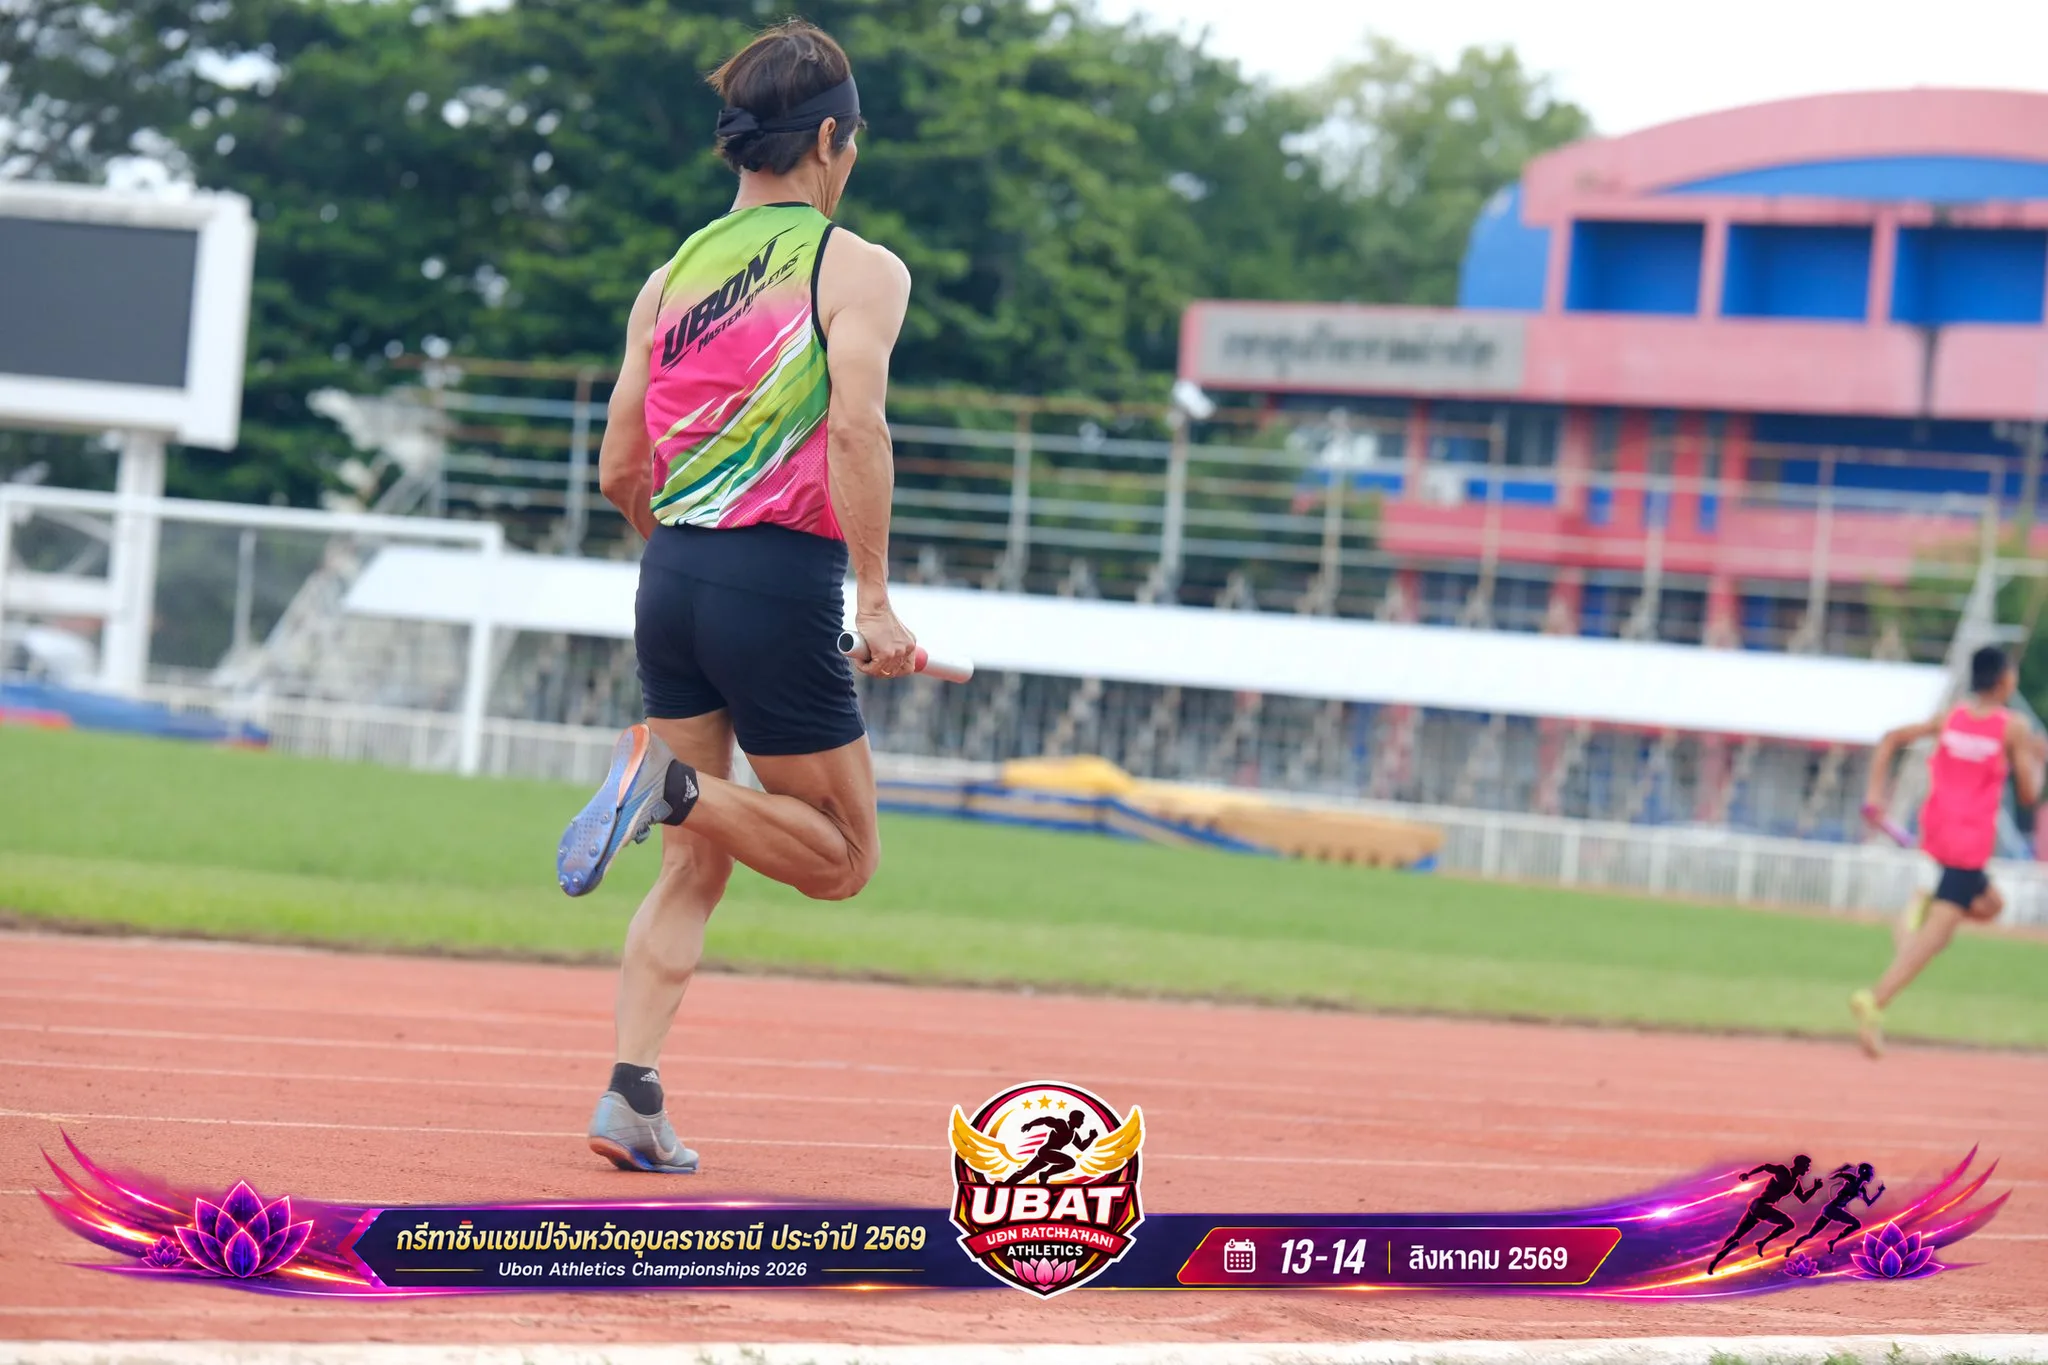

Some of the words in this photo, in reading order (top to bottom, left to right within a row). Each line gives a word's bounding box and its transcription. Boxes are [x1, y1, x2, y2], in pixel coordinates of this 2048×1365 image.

[660, 238, 778, 368] UBON
[697, 308, 742, 354] MASTER
[742, 254, 800, 313] ATHLETICS
